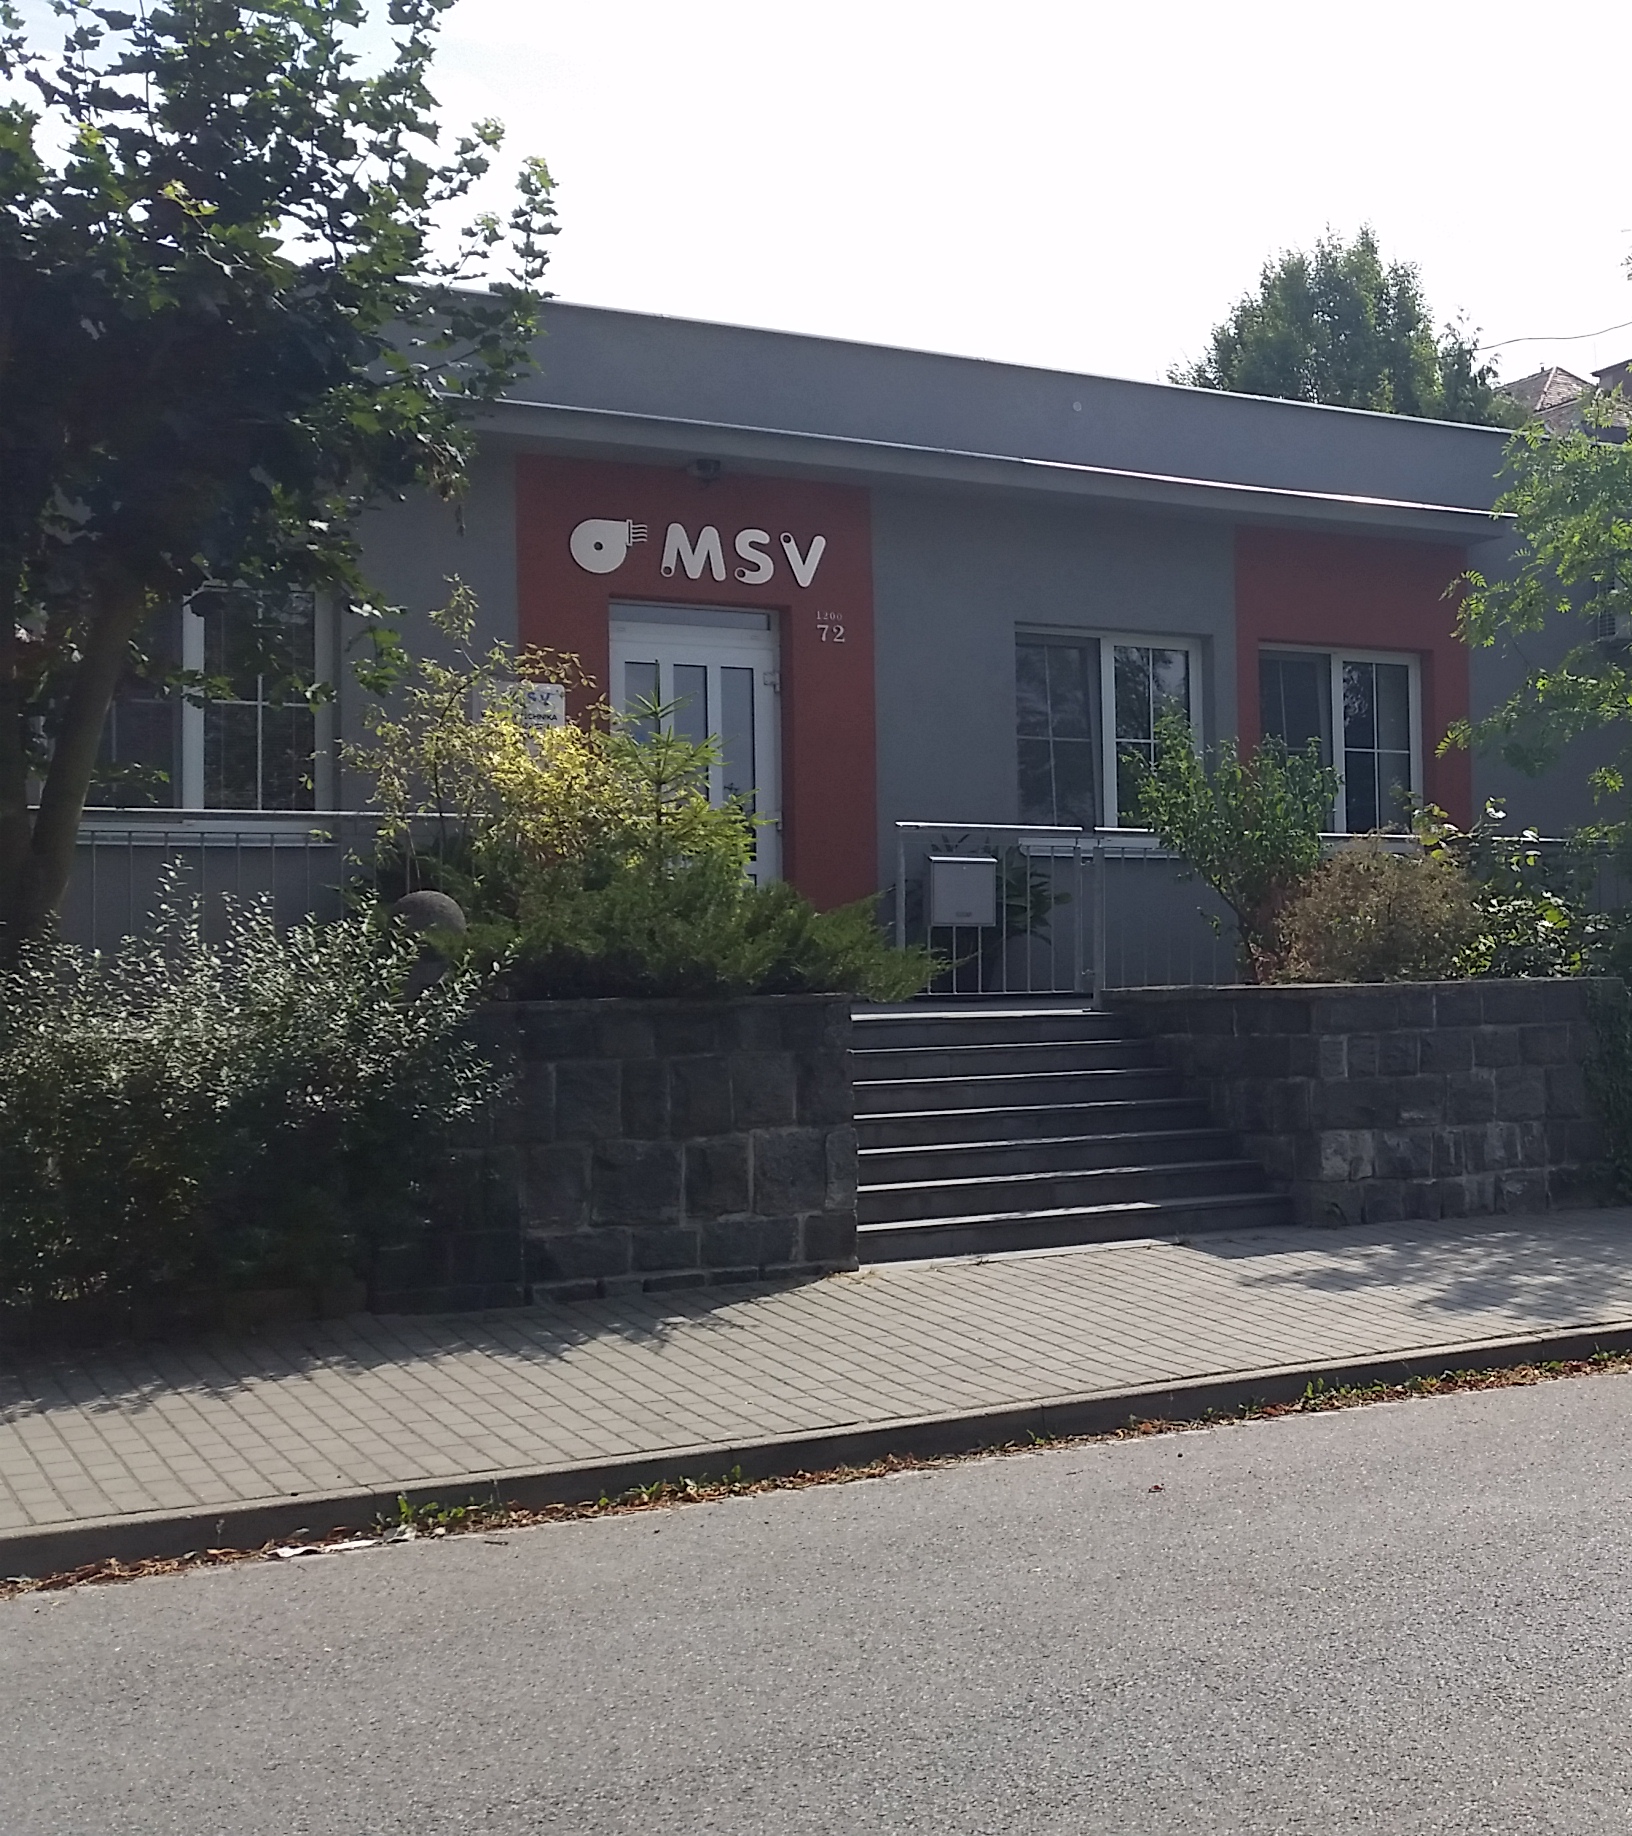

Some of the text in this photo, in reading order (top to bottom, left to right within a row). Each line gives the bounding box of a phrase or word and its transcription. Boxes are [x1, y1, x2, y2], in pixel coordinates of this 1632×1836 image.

[660, 522, 827, 588] MSV
[816, 610, 843, 621] 1200
[816, 624, 846, 642] 72
